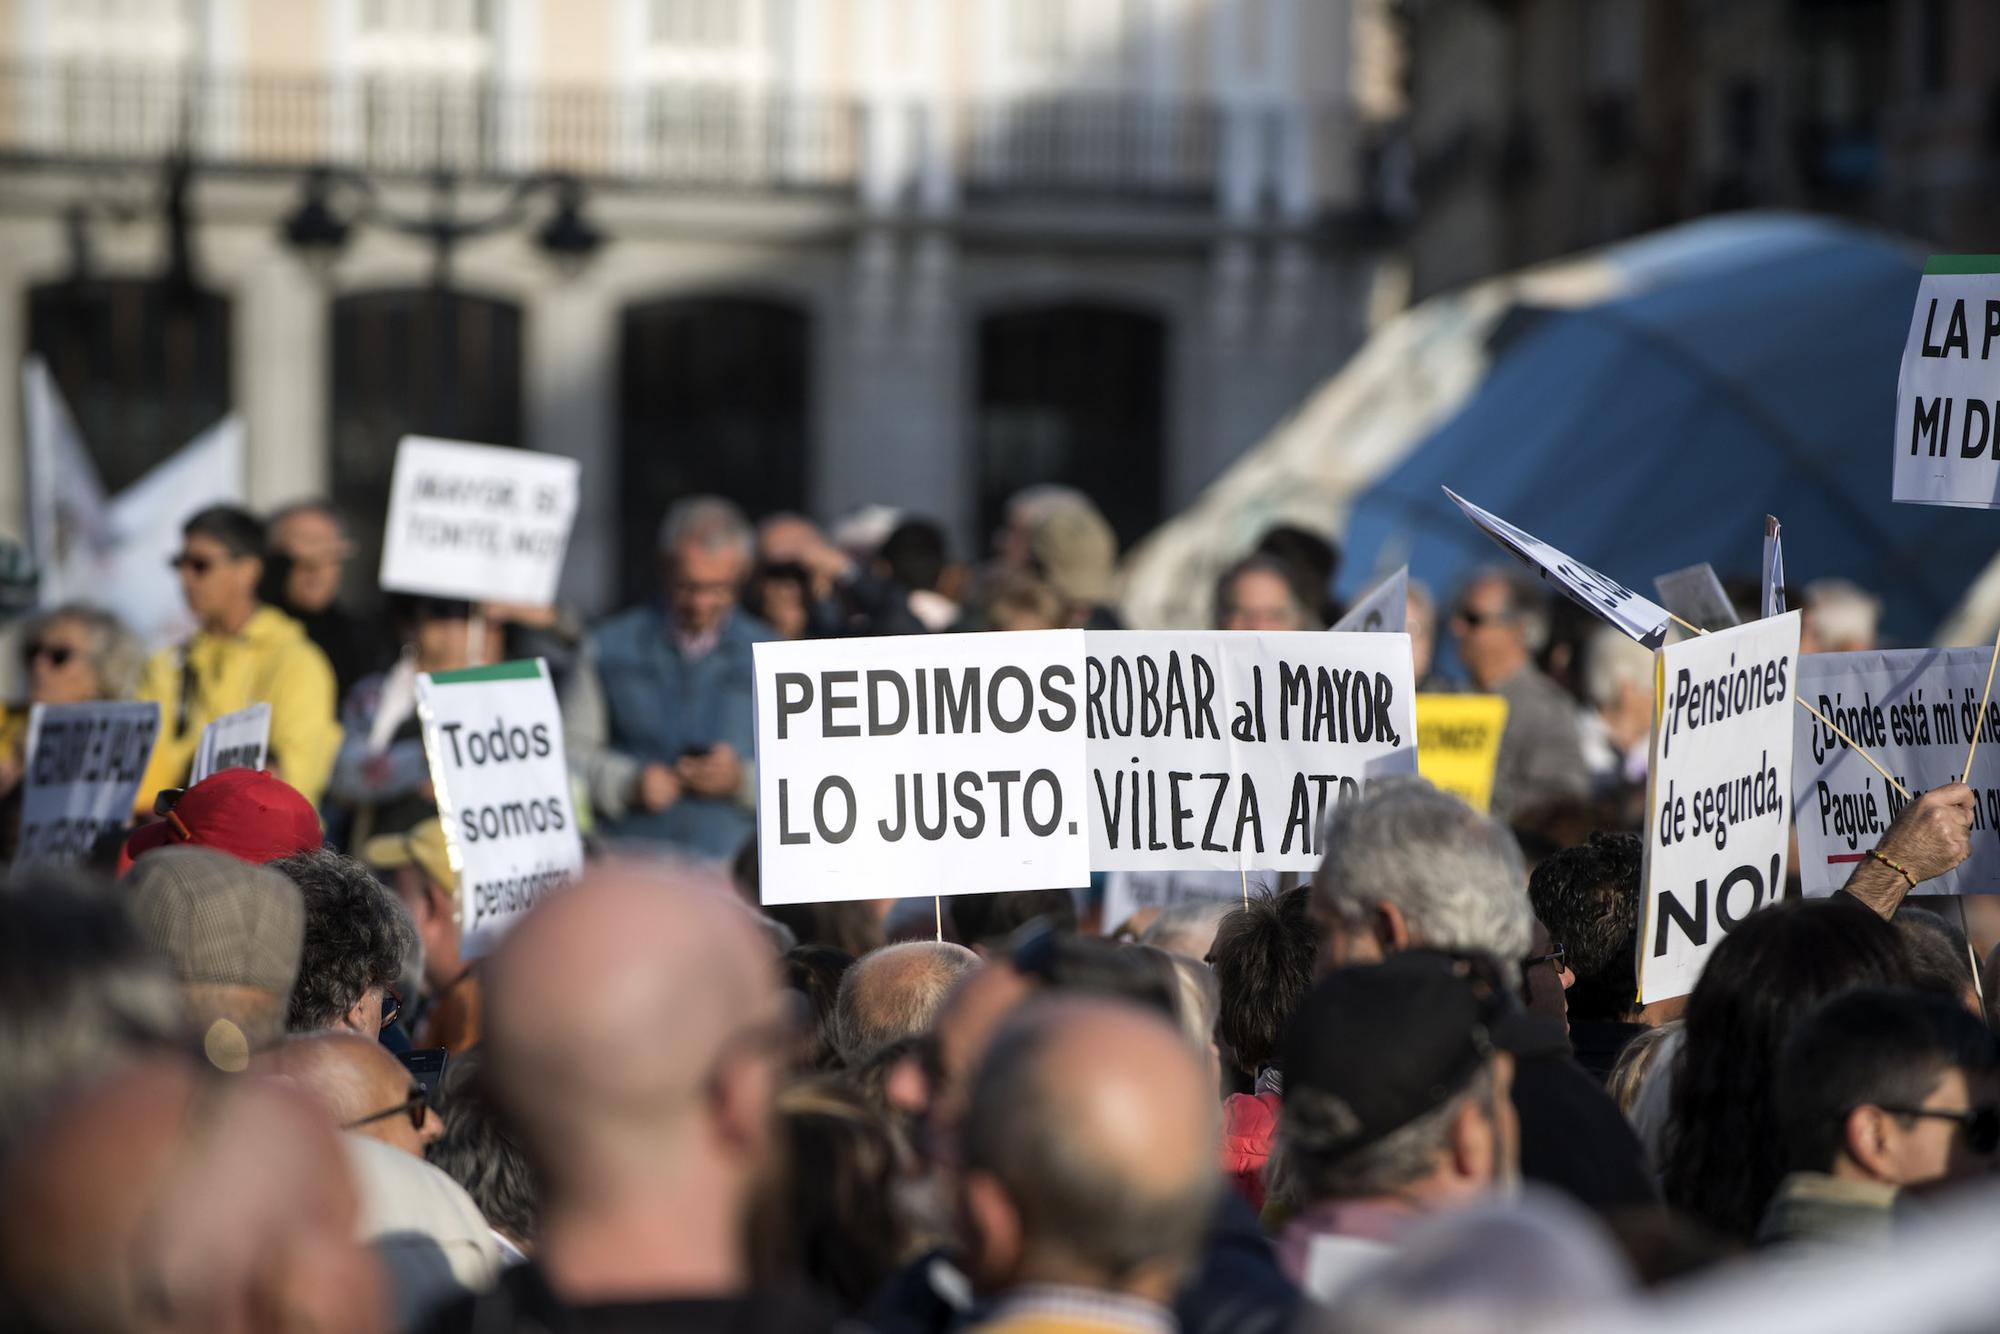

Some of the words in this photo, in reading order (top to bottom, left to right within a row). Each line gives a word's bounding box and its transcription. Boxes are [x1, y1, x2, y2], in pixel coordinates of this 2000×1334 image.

[1922, 299, 1969, 359] LA
[1911, 397, 1953, 458] MI
[775, 665, 1077, 740] PEDIMOS
[1086, 650, 1221, 740] ROBAR
[1231, 665, 1266, 743] al
[1279, 660, 1401, 747] MAYOR,
[1664, 652, 1788, 760] ¡Pensiones
[1812, 692, 1887, 765] ¿Dónde
[1890, 688, 1932, 747] está
[1932, 688, 1959, 745] mi
[441, 716, 551, 769] Todos
[461, 798, 566, 843] somos
[778, 775, 857, 845] LO
[877, 768, 1078, 843] JUSTO.
[1660, 780, 1686, 847] de
[1692, 750, 1783, 851] segunda,
[1817, 777, 1886, 851] Pagué.
[1654, 853, 1780, 957] NO!
